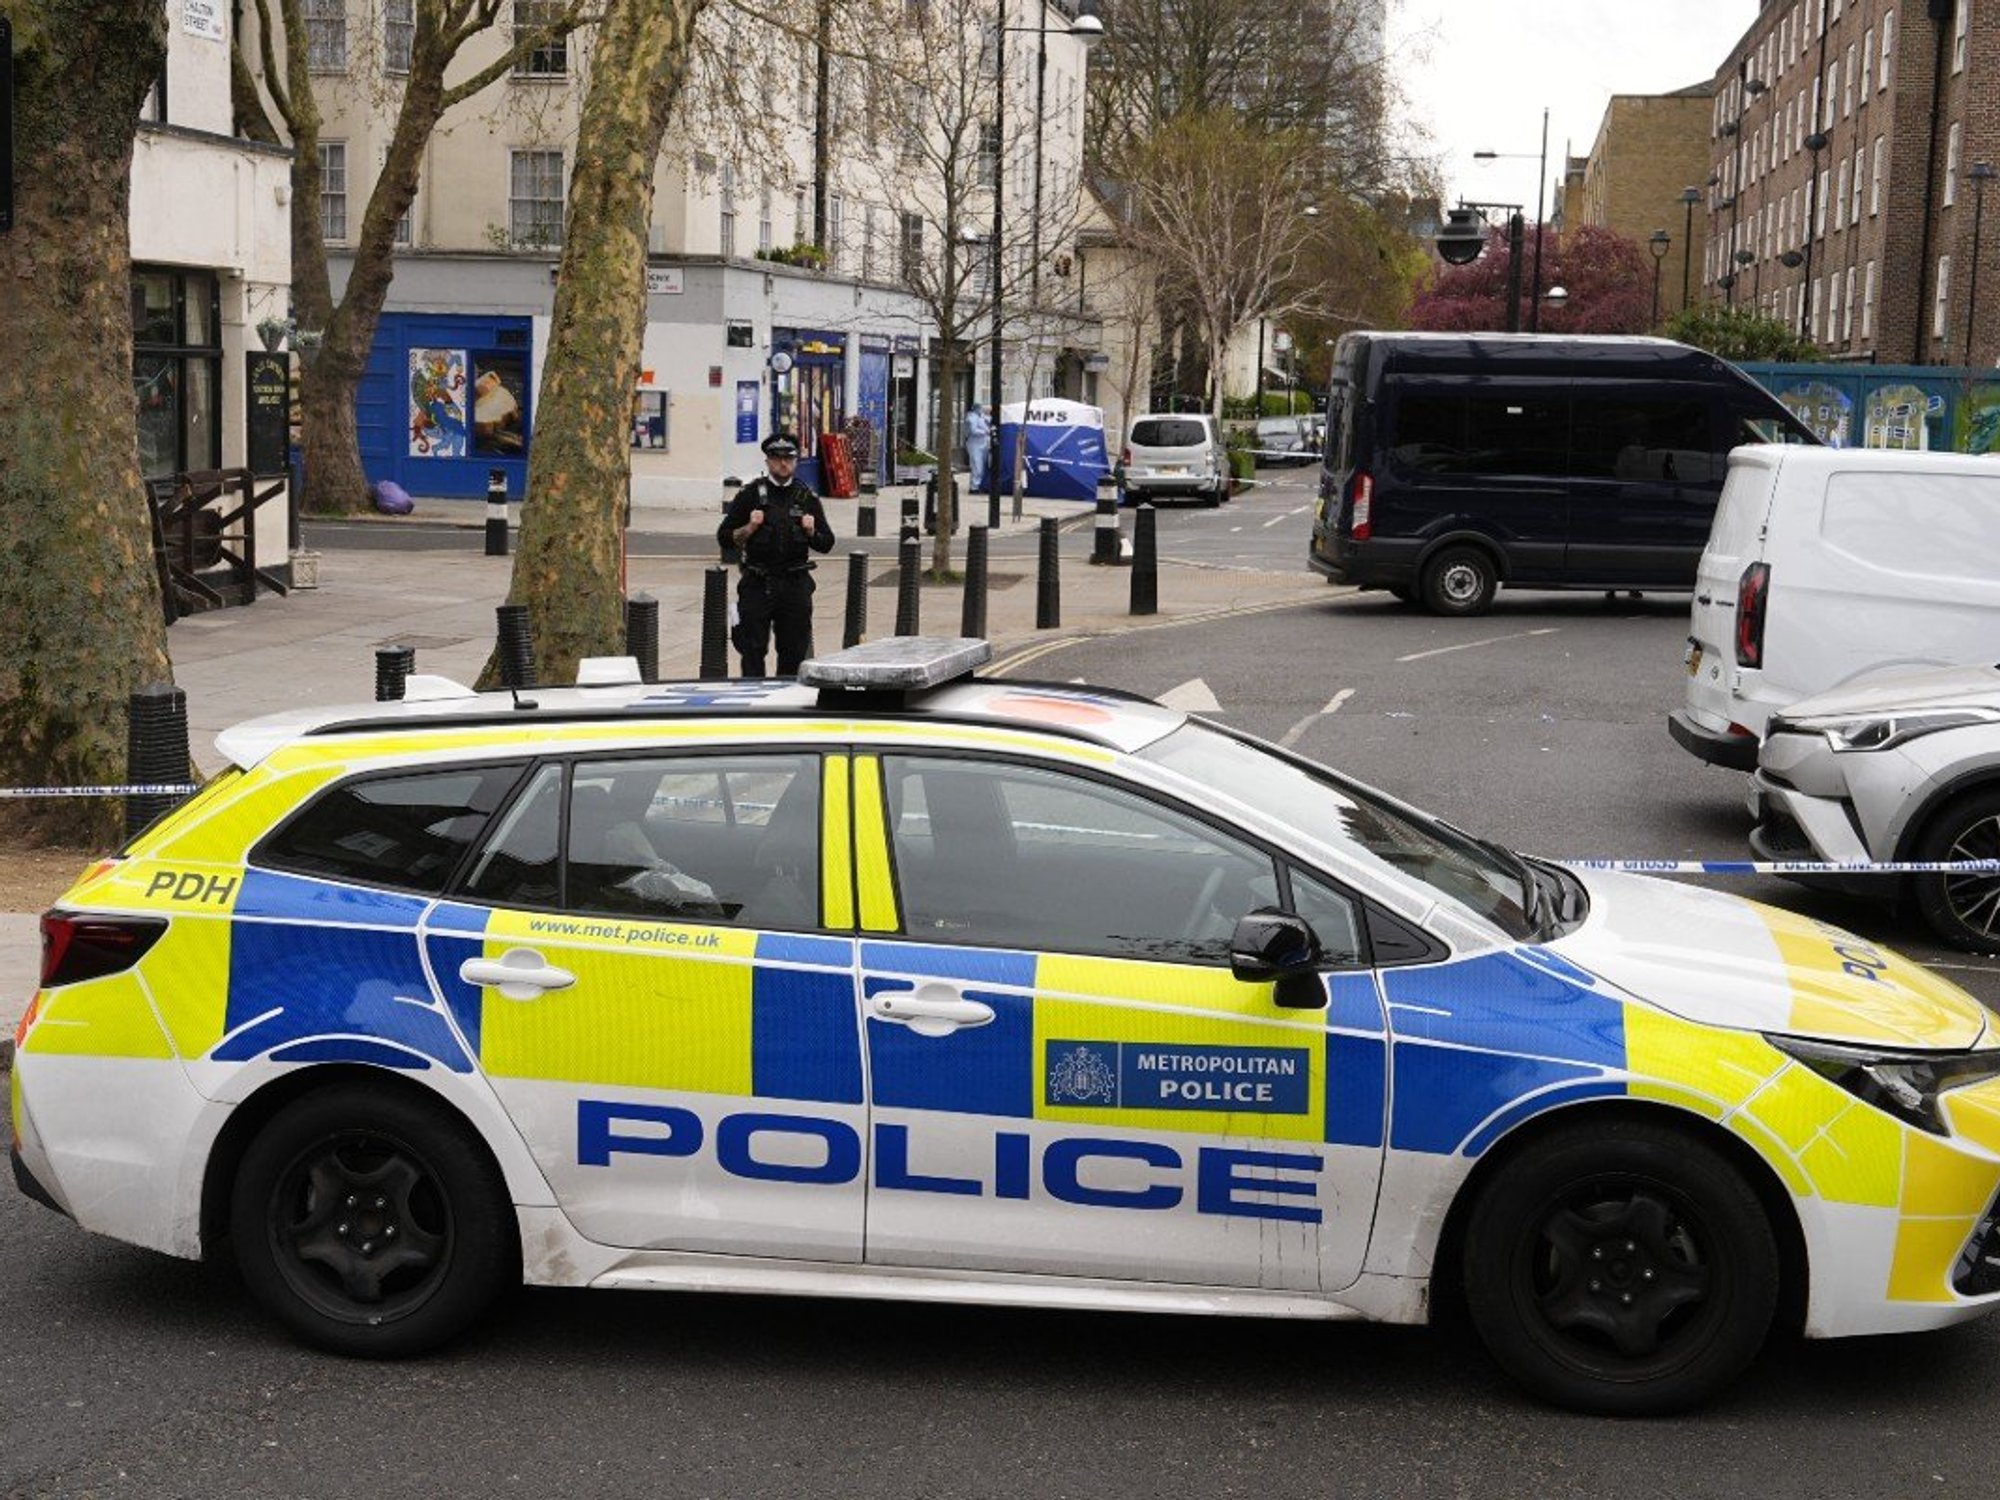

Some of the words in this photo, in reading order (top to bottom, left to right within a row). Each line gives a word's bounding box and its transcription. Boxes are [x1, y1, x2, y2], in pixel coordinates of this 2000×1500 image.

[184, 14, 209, 31] STREET
[1027, 410, 1068, 423] MPS
[146, 871, 238, 904] PDH
[530, 919, 721, 947] www.met.police.uk
[1137, 1053, 1295, 1076] METROPOLITAN
[1160, 1080, 1274, 1102] POLICE
[578, 1100, 1324, 1224] POLICE
